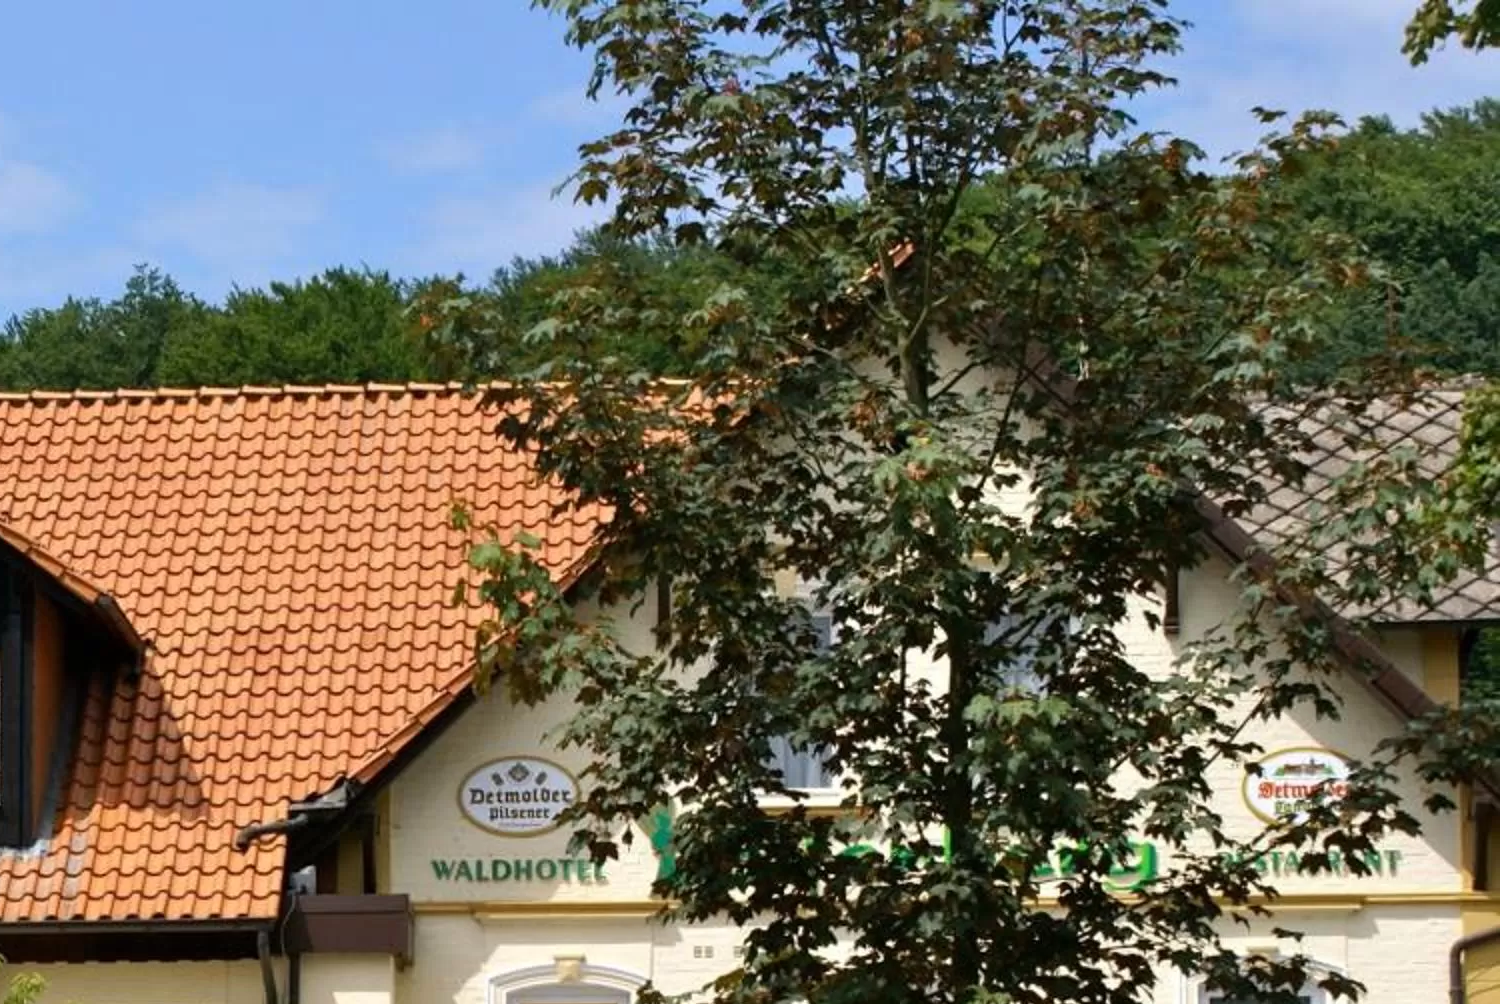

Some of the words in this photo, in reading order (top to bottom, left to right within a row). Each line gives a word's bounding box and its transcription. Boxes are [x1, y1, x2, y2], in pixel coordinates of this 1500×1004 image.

[469, 787, 572, 804] Detmolder
[489, 805, 551, 821] Pilsener
[431, 859, 609, 882] WALDHOTEL
